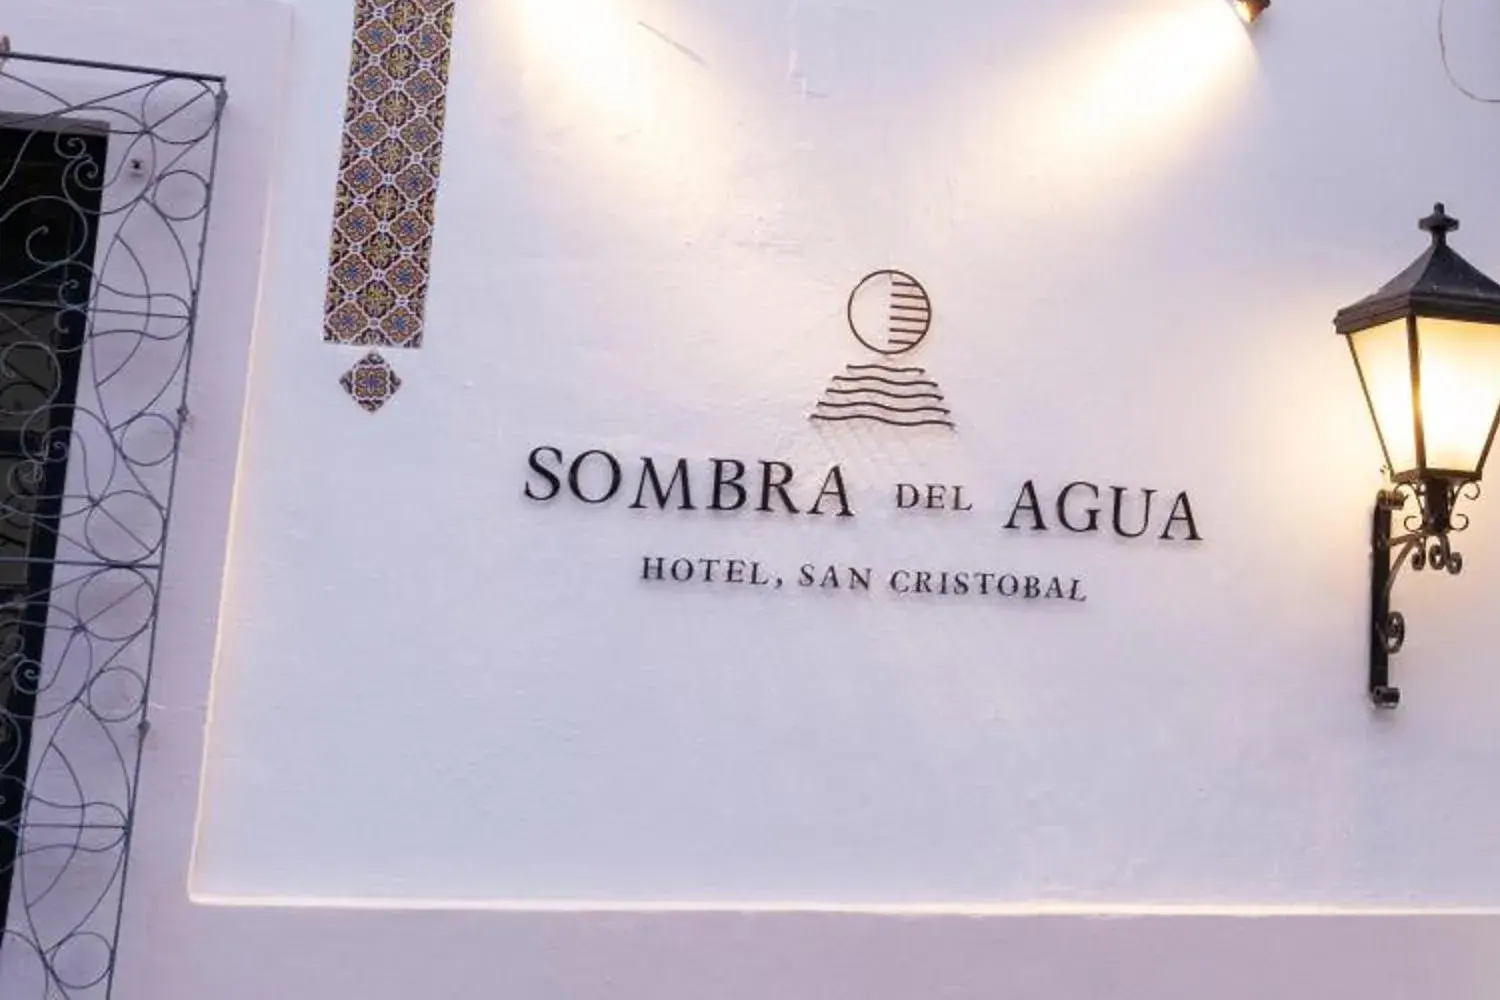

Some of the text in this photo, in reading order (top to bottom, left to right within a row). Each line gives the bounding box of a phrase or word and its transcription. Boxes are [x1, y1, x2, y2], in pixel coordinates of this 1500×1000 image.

[523, 446, 1203, 541] SOMBRA DEL AGUA
[641, 556, 1087, 602] HOTEL, SAN CRISTOBAL
